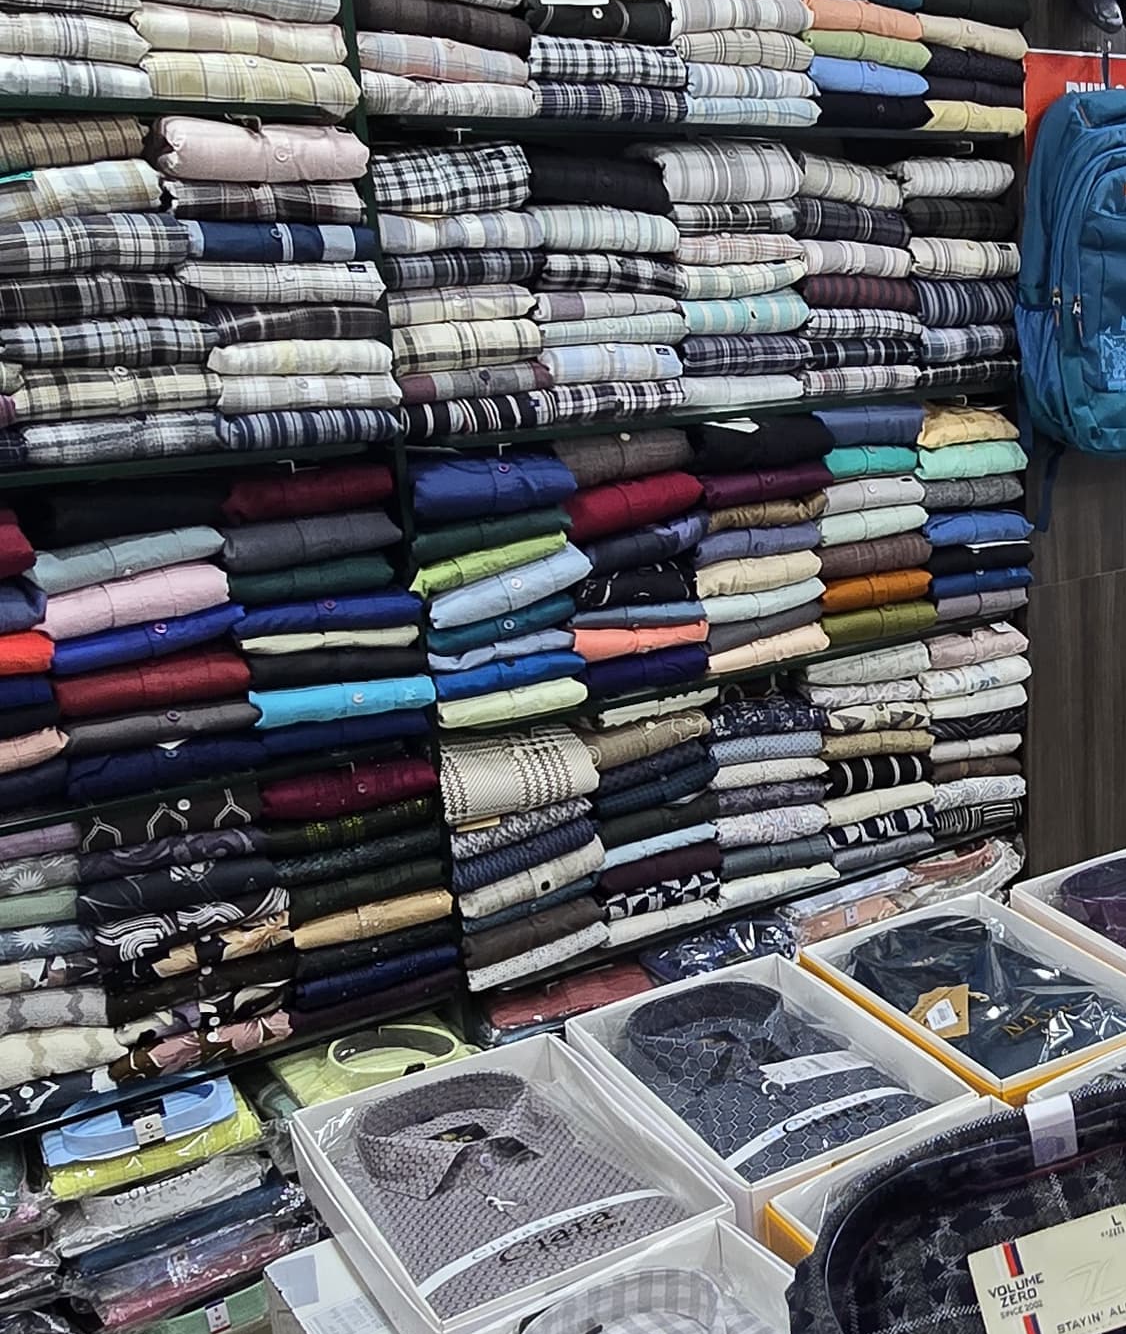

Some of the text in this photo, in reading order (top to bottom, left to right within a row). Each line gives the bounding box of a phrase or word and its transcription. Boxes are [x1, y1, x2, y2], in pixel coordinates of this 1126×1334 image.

[1111, 1214, 1122, 1226] L
[499, 1210, 613, 1264] Ciara
[988, 1272, 1045, 1299] VOLUME
[1001, 1287, 1038, 1309] ZERO
[1056, 1310, 1105, 1334] STAYIN'
